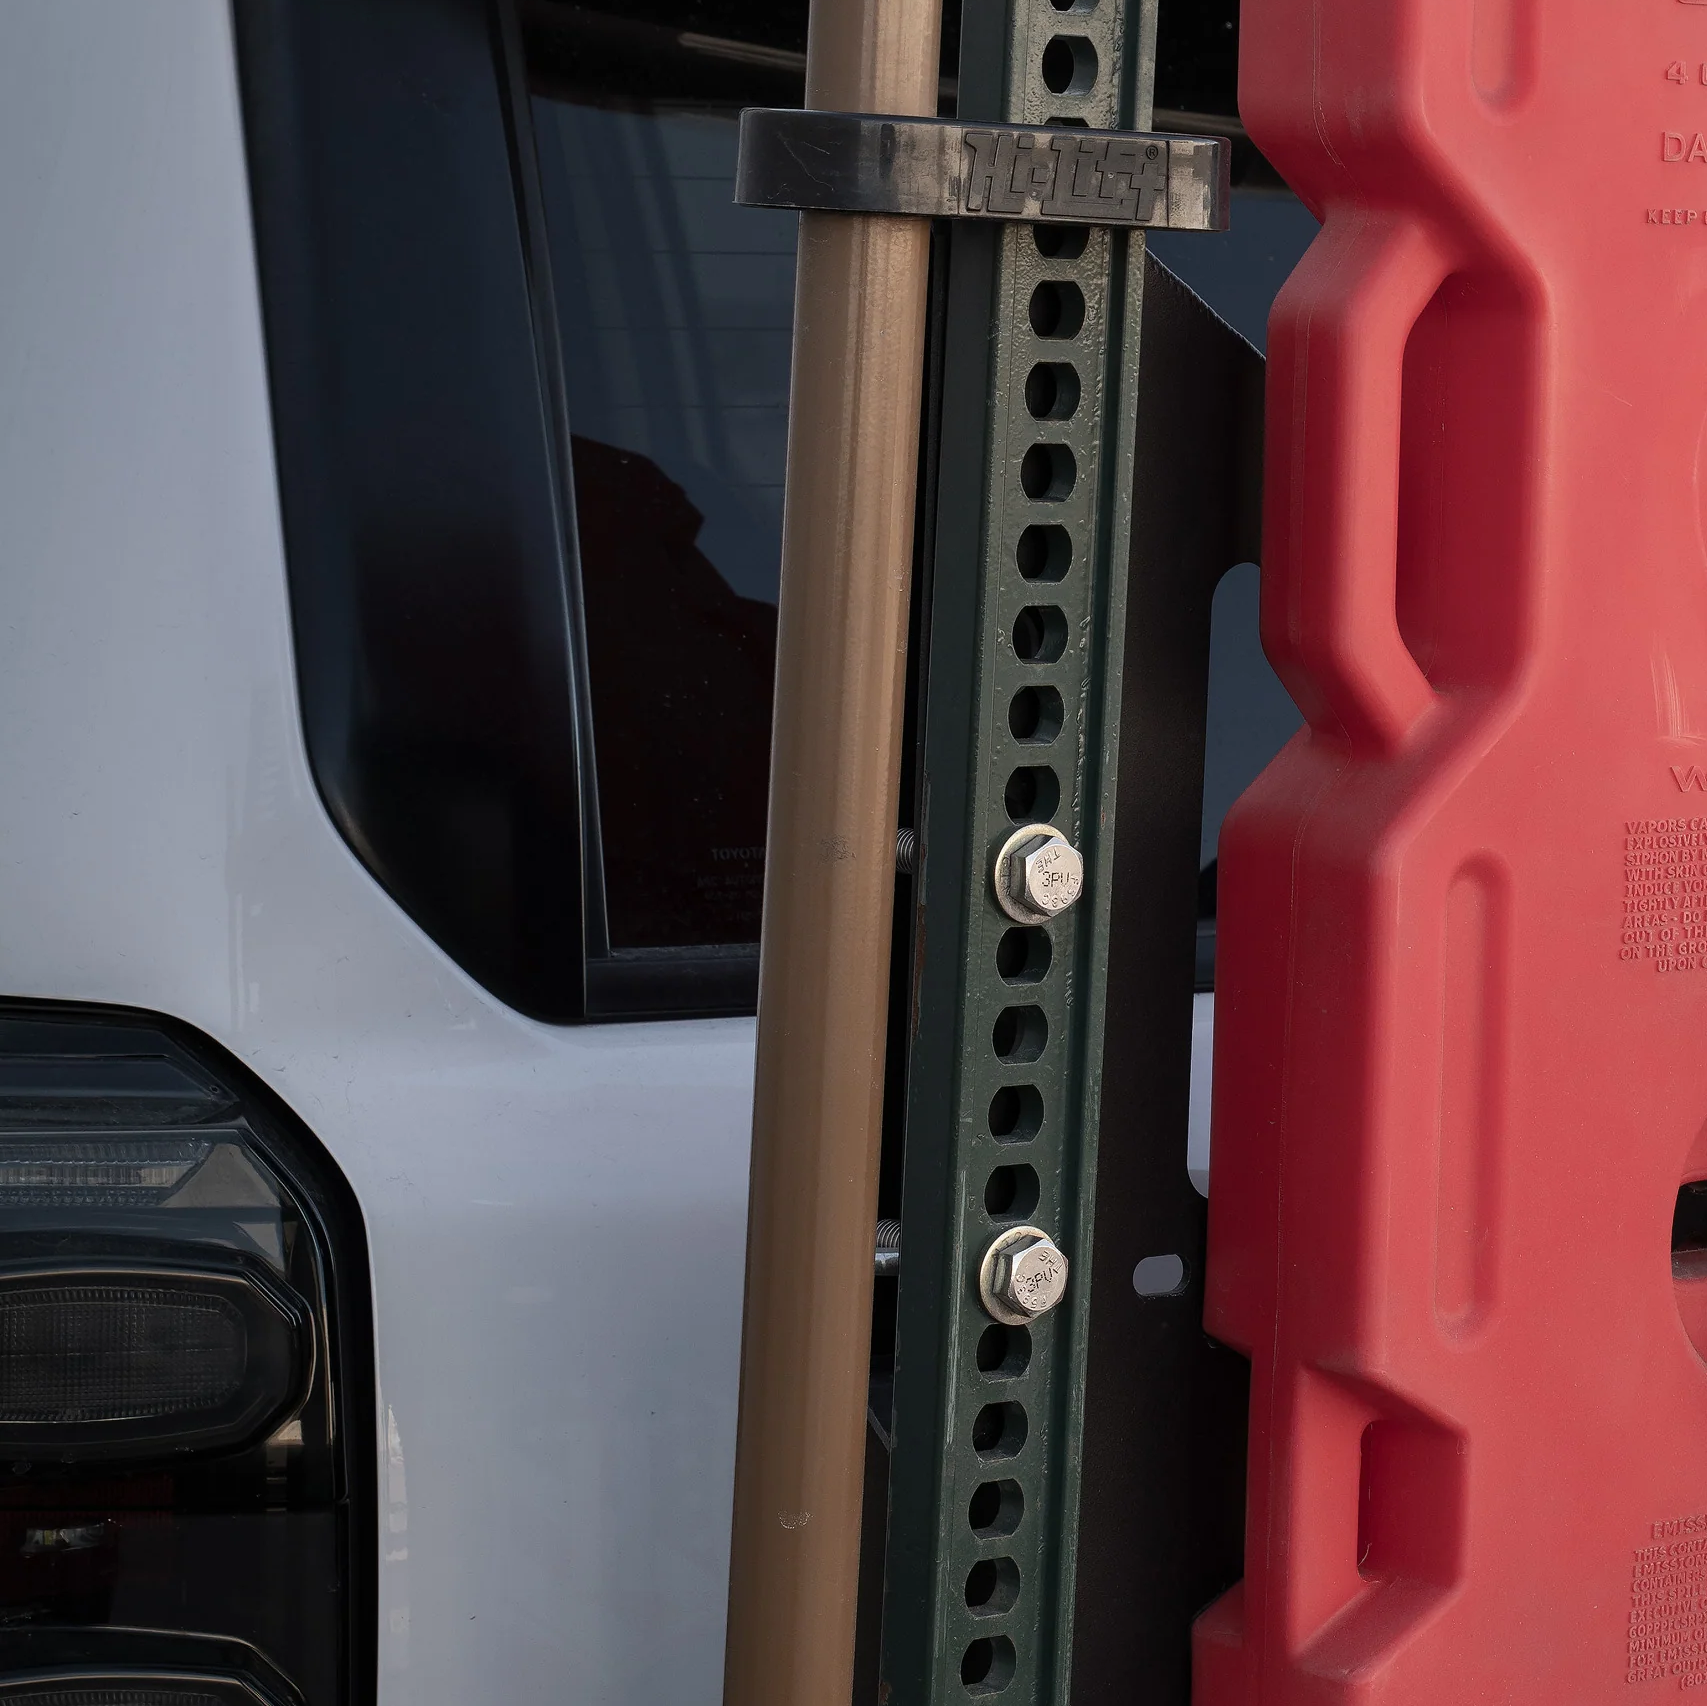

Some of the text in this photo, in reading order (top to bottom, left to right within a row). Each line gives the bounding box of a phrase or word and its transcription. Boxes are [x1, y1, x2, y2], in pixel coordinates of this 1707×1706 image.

[1665, 61, 1689, 85] 4
[1646, 208, 1698, 225] KEEP
[1624, 817, 1686, 835] VAPORS
[1624, 849, 1678, 866] SIPHON
[1680, 847, 1698, 862] BY
[1624, 865, 1662, 882] WITH
[1665, 863, 1698, 879] SKIN
[1624, 880, 1680, 898] INDUCE
[1622, 895, 1680, 912] TIGHTLY
[1621, 912, 1668, 929] AREAS
[1682, 909, 1700, 924] DO
[1622, 929, 1654, 945] OUT
[1660, 927, 1678, 941] OF
[1618, 946, 1640, 961] ON
[1646, 943, 1672, 959] THE
[1657, 955, 1696, 972] UPON
